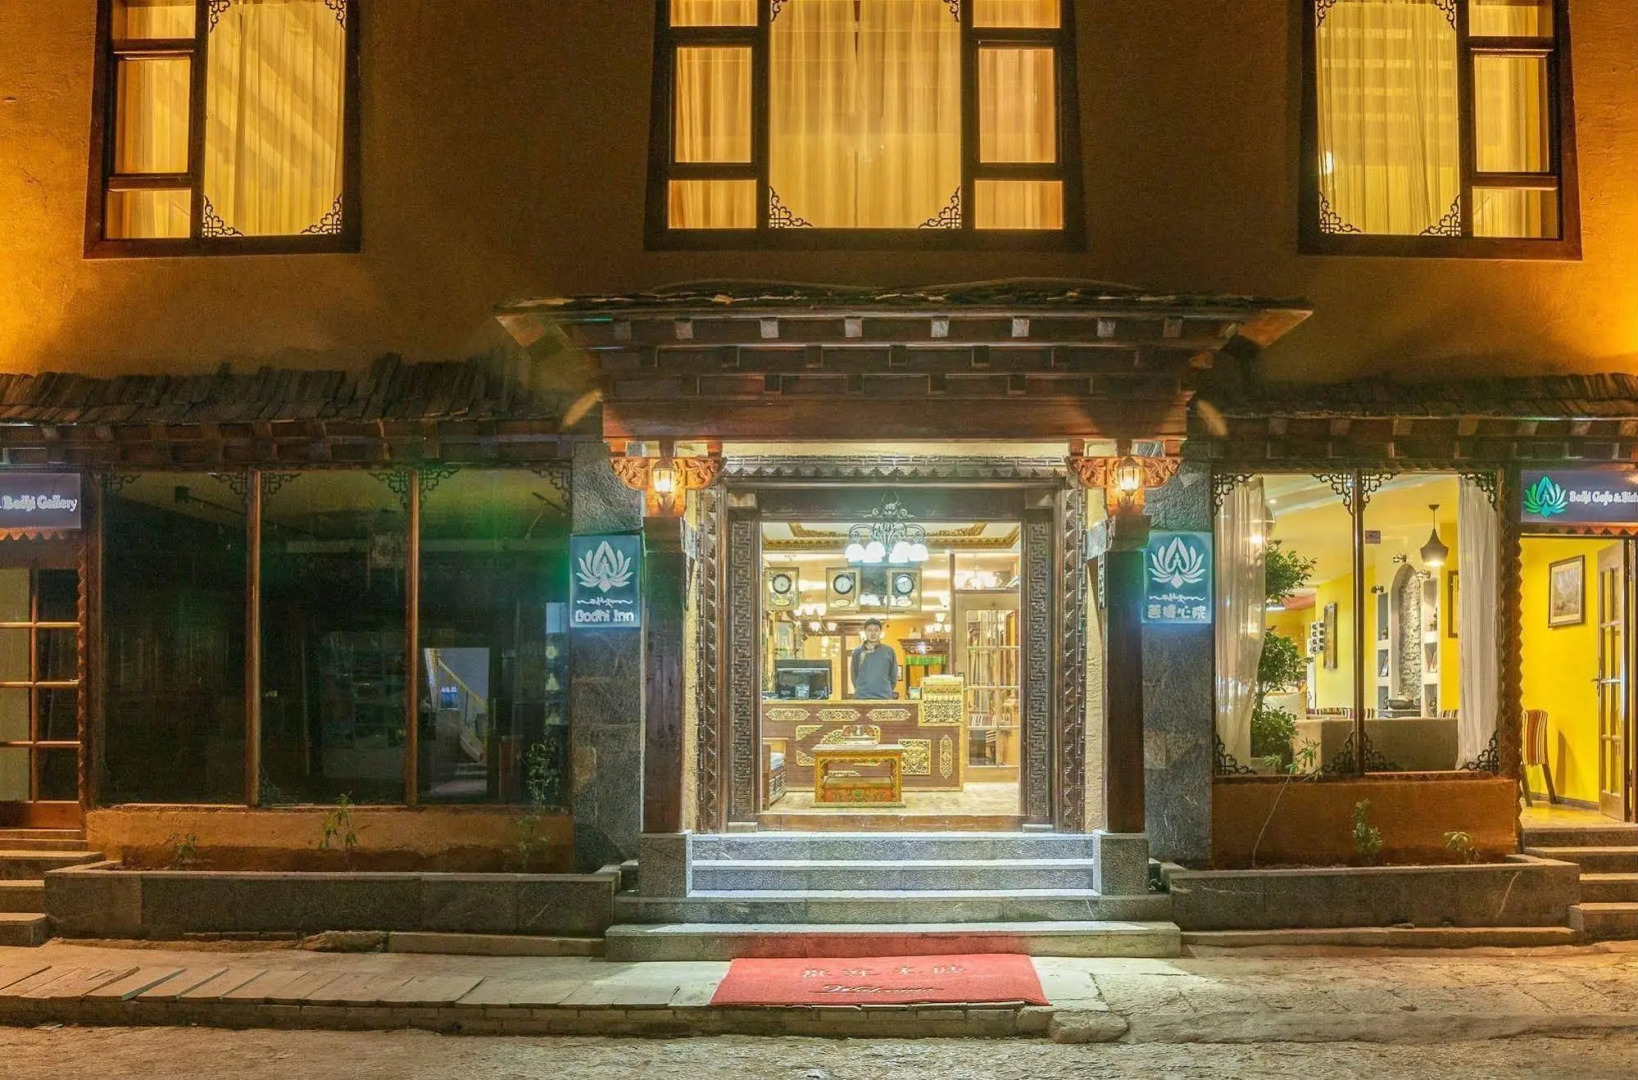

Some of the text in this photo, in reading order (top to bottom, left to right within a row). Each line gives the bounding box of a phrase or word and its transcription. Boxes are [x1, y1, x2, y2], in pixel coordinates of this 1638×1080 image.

[37, 494, 78, 512] Gallery
[575, 609, 635, 623] Bodhi Inn
